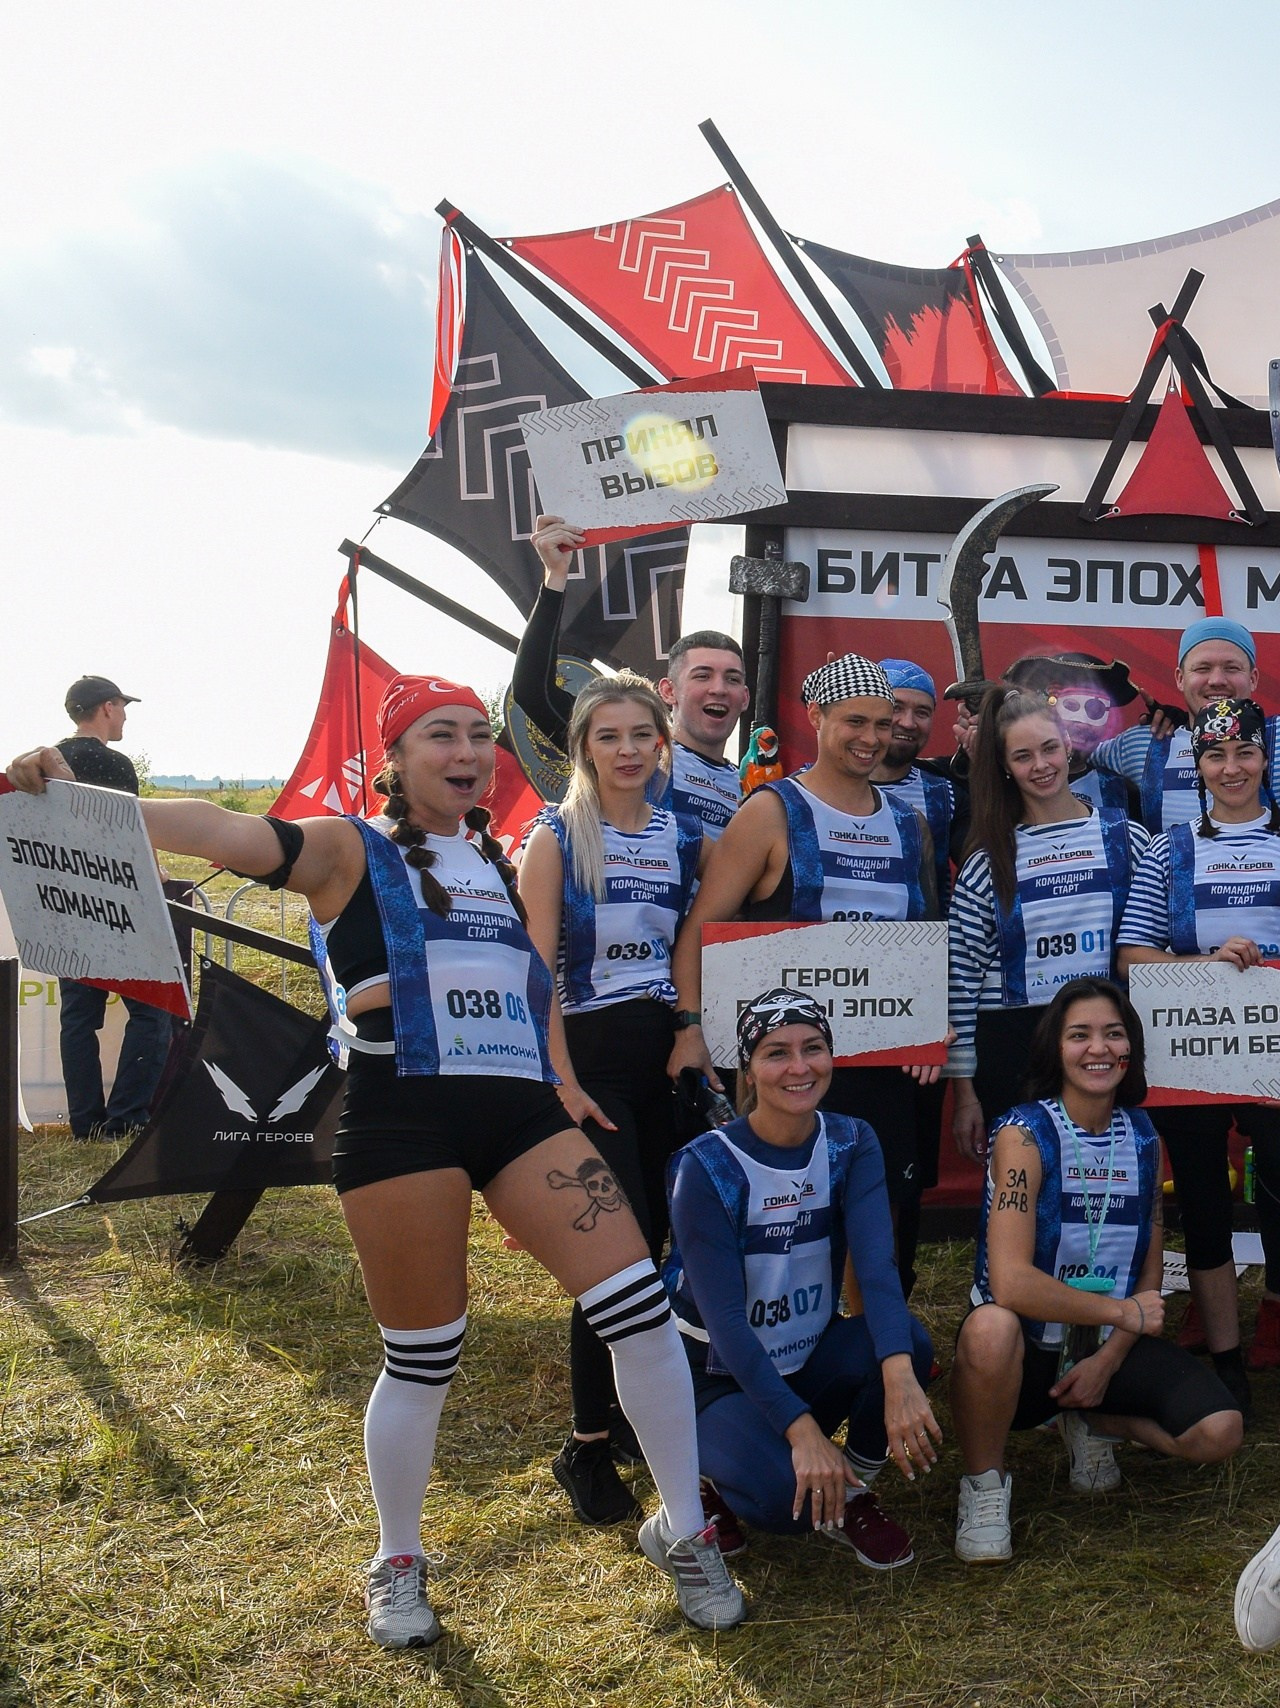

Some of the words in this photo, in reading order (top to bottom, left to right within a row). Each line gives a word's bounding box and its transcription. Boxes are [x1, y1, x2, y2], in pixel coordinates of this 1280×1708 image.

[580, 414, 719, 465] ПРИНЯЛ
[600, 453, 719, 500] ВЫЗОВ
[817, 549, 1027, 601] БИТА
[1047, 558, 1205, 607] ЭПОХ
[685, 773, 712, 787] ГОНКА
[701, 809, 726, 824] СТАРТ
[829, 830, 857, 841] ГОНКА
[859, 833, 890, 843] ГЕРОЕВ
[6, 836, 139, 891] ЭПОХАЛЬНАЯ
[604, 854, 632, 865] ГОНКА
[634, 858, 669, 868] ГЕРОЕВ
[836, 855, 890, 870] КОМАНДНЫЙ
[1028, 854, 1058, 866] ГОНКА
[1059, 850, 1093, 859] ГЕРОЕВ
[851, 869, 875, 879] СТАРТ
[1207, 862, 1237, 871] ГОНКА
[1239, 862, 1273, 870] ГЕРОЕВ
[611, 878, 670, 894] КОМАНДНЫЙ
[1035, 870, 1094, 887] КОМАНДНЫЙ
[469, 889, 506, 900] ГЕРОЕВ
[1052, 884, 1080, 895] СТАРТ
[1210, 881, 1271, 894] КОМАНДНЫЙ
[631, 890, 656, 902] СТАРТ
[1227, 895, 1256, 905] СТАРТ
[37, 883, 136, 934] КОМАНДА
[467, 926, 499, 939] СТАРТ
[607, 941, 651, 960] 039
[1036, 933, 1077, 959] 039
[1081, 929, 1106, 953] 01
[781, 968, 869, 987] ГЕРОИ
[446, 989, 502, 1019] 038
[505, 991, 527, 1024] 06
[842, 998, 914, 1017] ЭПОХ
[1152, 1007, 1236, 1027] ГЛАЗА
[477, 1043, 539, 1061] АММОНИЙ
[1170, 1037, 1239, 1057] НОГИ
[213, 1131, 250, 1141] ЛИГА
[256, 1133, 314, 1142] ГЕРОЕВ
[1006, 1168, 1027, 1189] ЗА
[763, 1194, 797, 1207] ГОНКА
[997, 1191, 1028, 1213] ВДВ
[751, 1295, 791, 1328] 038
[792, 1284, 823, 1315] 07
